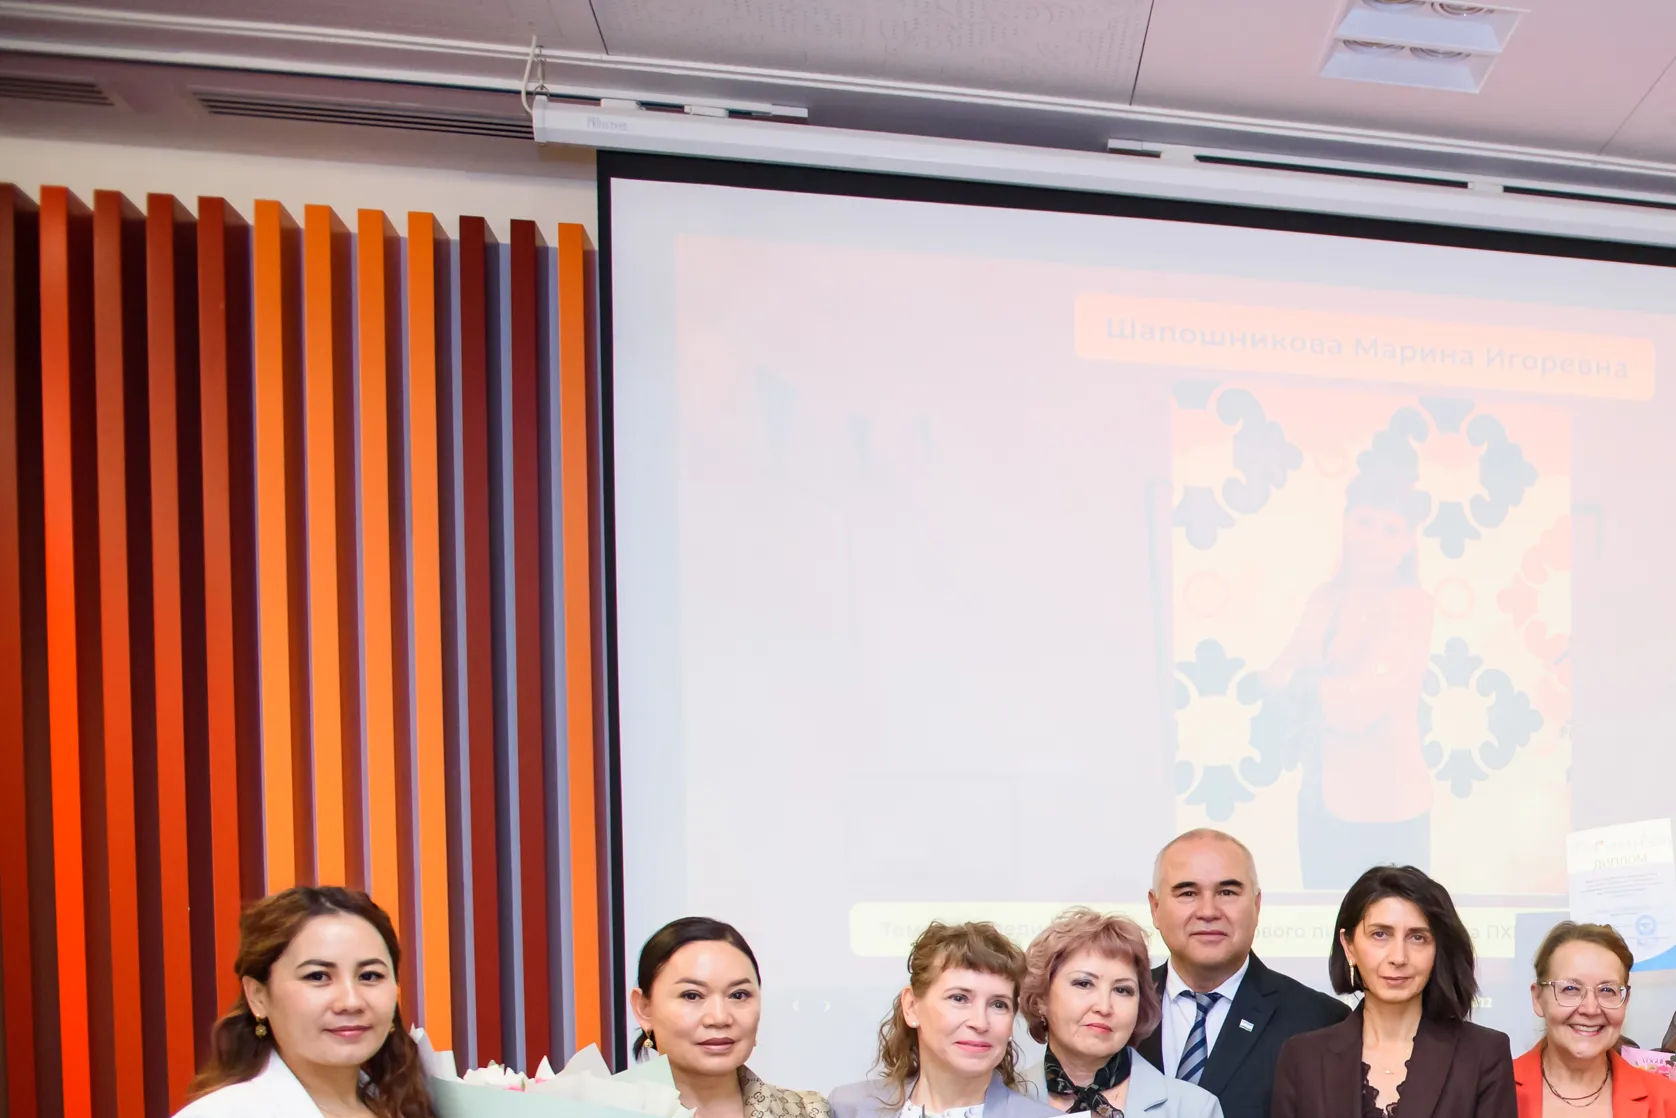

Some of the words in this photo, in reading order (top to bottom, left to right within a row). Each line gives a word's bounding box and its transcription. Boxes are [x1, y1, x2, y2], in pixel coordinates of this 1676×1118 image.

[1105, 317, 1344, 356] Шапошникова
[1353, 336, 1475, 366] Марина
[1484, 346, 1631, 379] Игоревна
[1592, 853, 1648, 872] ДИПЛОМ
